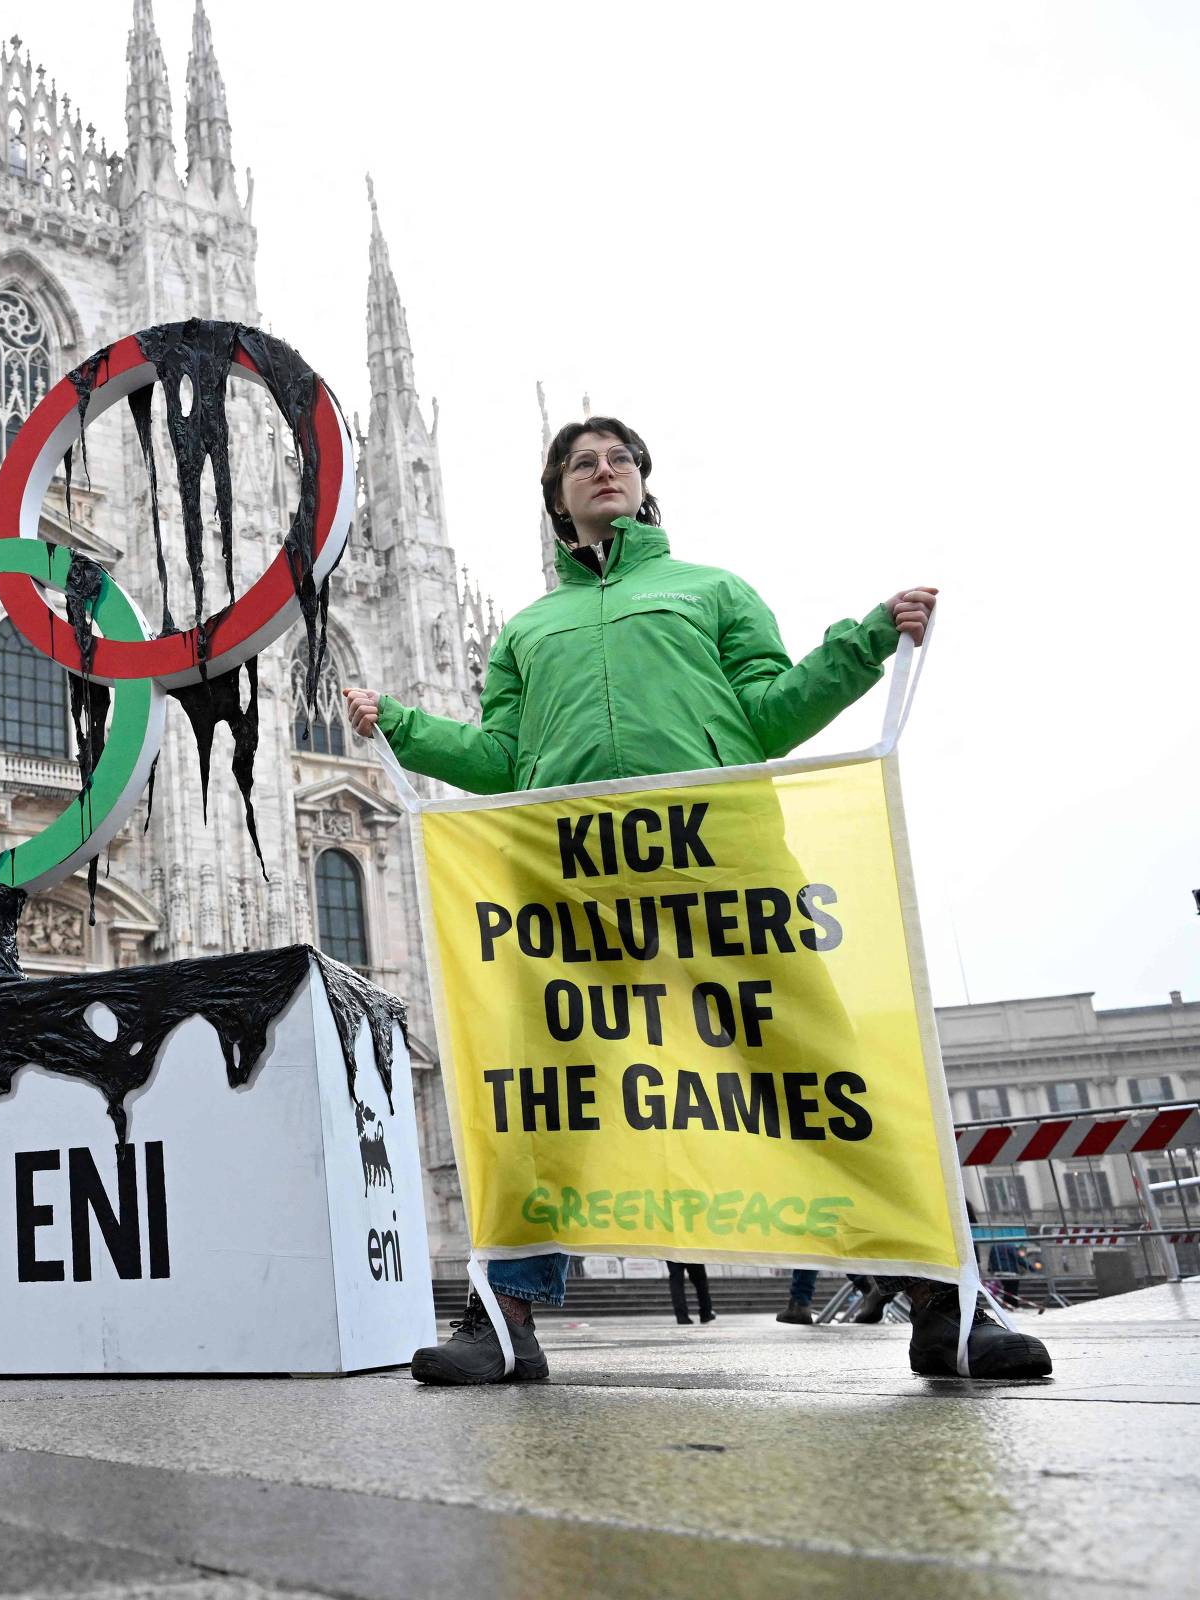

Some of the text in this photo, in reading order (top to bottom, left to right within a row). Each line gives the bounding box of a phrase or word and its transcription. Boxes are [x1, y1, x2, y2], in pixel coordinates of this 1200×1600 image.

[556, 802, 716, 880] KICK
[475, 883, 844, 963] POLLUTERS
[544, 979, 773, 1048] OUT OF
[484, 1063, 874, 1142] THE GAMES
[14, 1140, 170, 1283] ENI
[367, 1210, 403, 1282] eni
[521, 1186, 854, 1238] GREENPEACE
